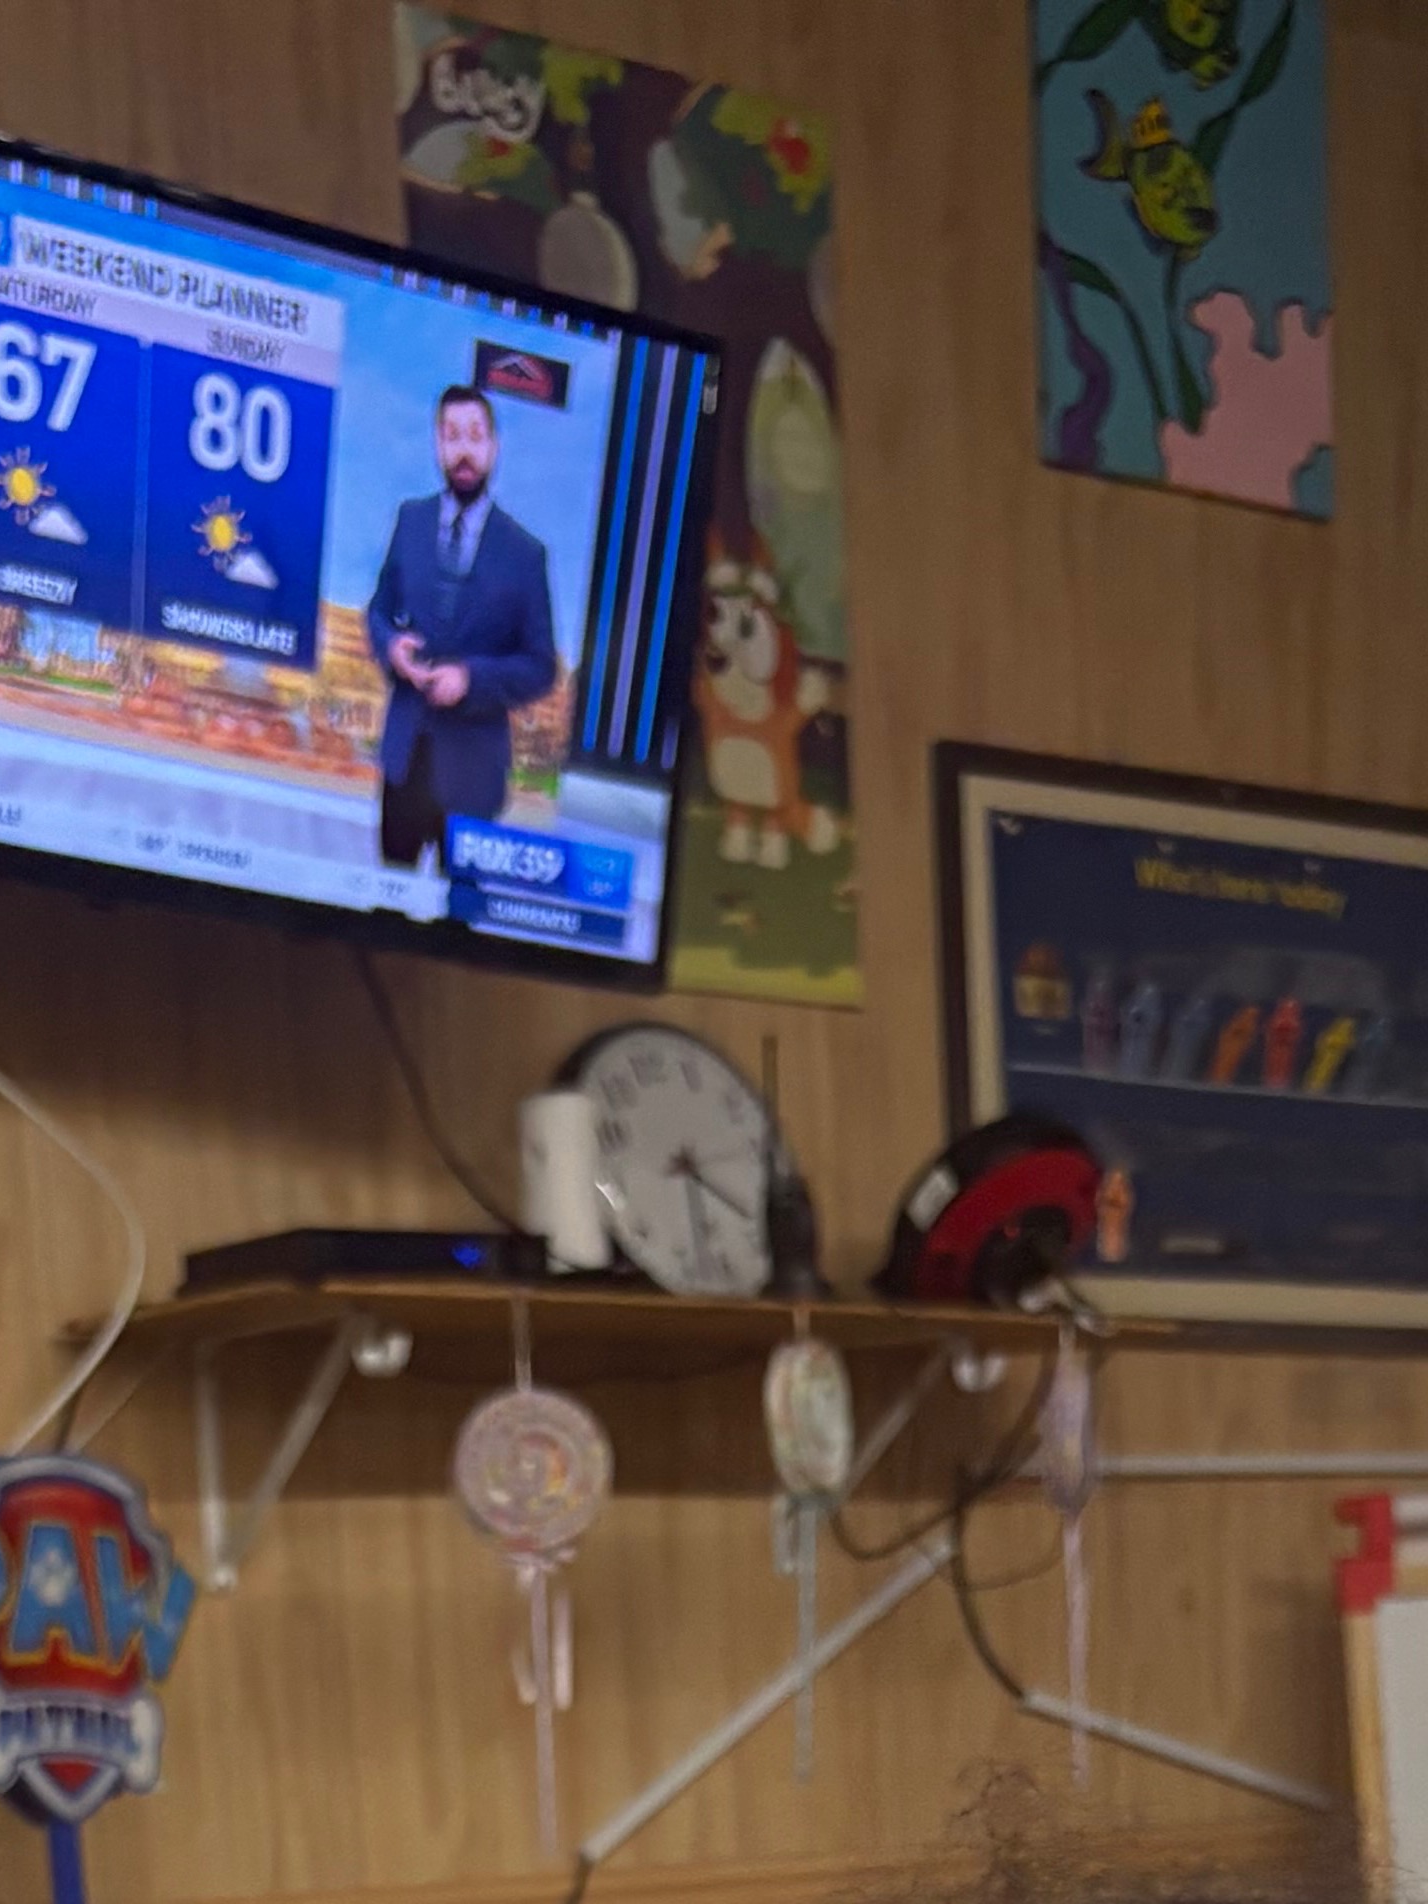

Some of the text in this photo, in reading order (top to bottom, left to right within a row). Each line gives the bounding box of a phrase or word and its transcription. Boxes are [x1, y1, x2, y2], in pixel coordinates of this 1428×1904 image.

[18, 228, 171, 299] WEEKEND
[178, 270, 311, 333] PLANNER
[206, 327, 289, 365] SUNDAY
[187, 371, 293, 483] 80
